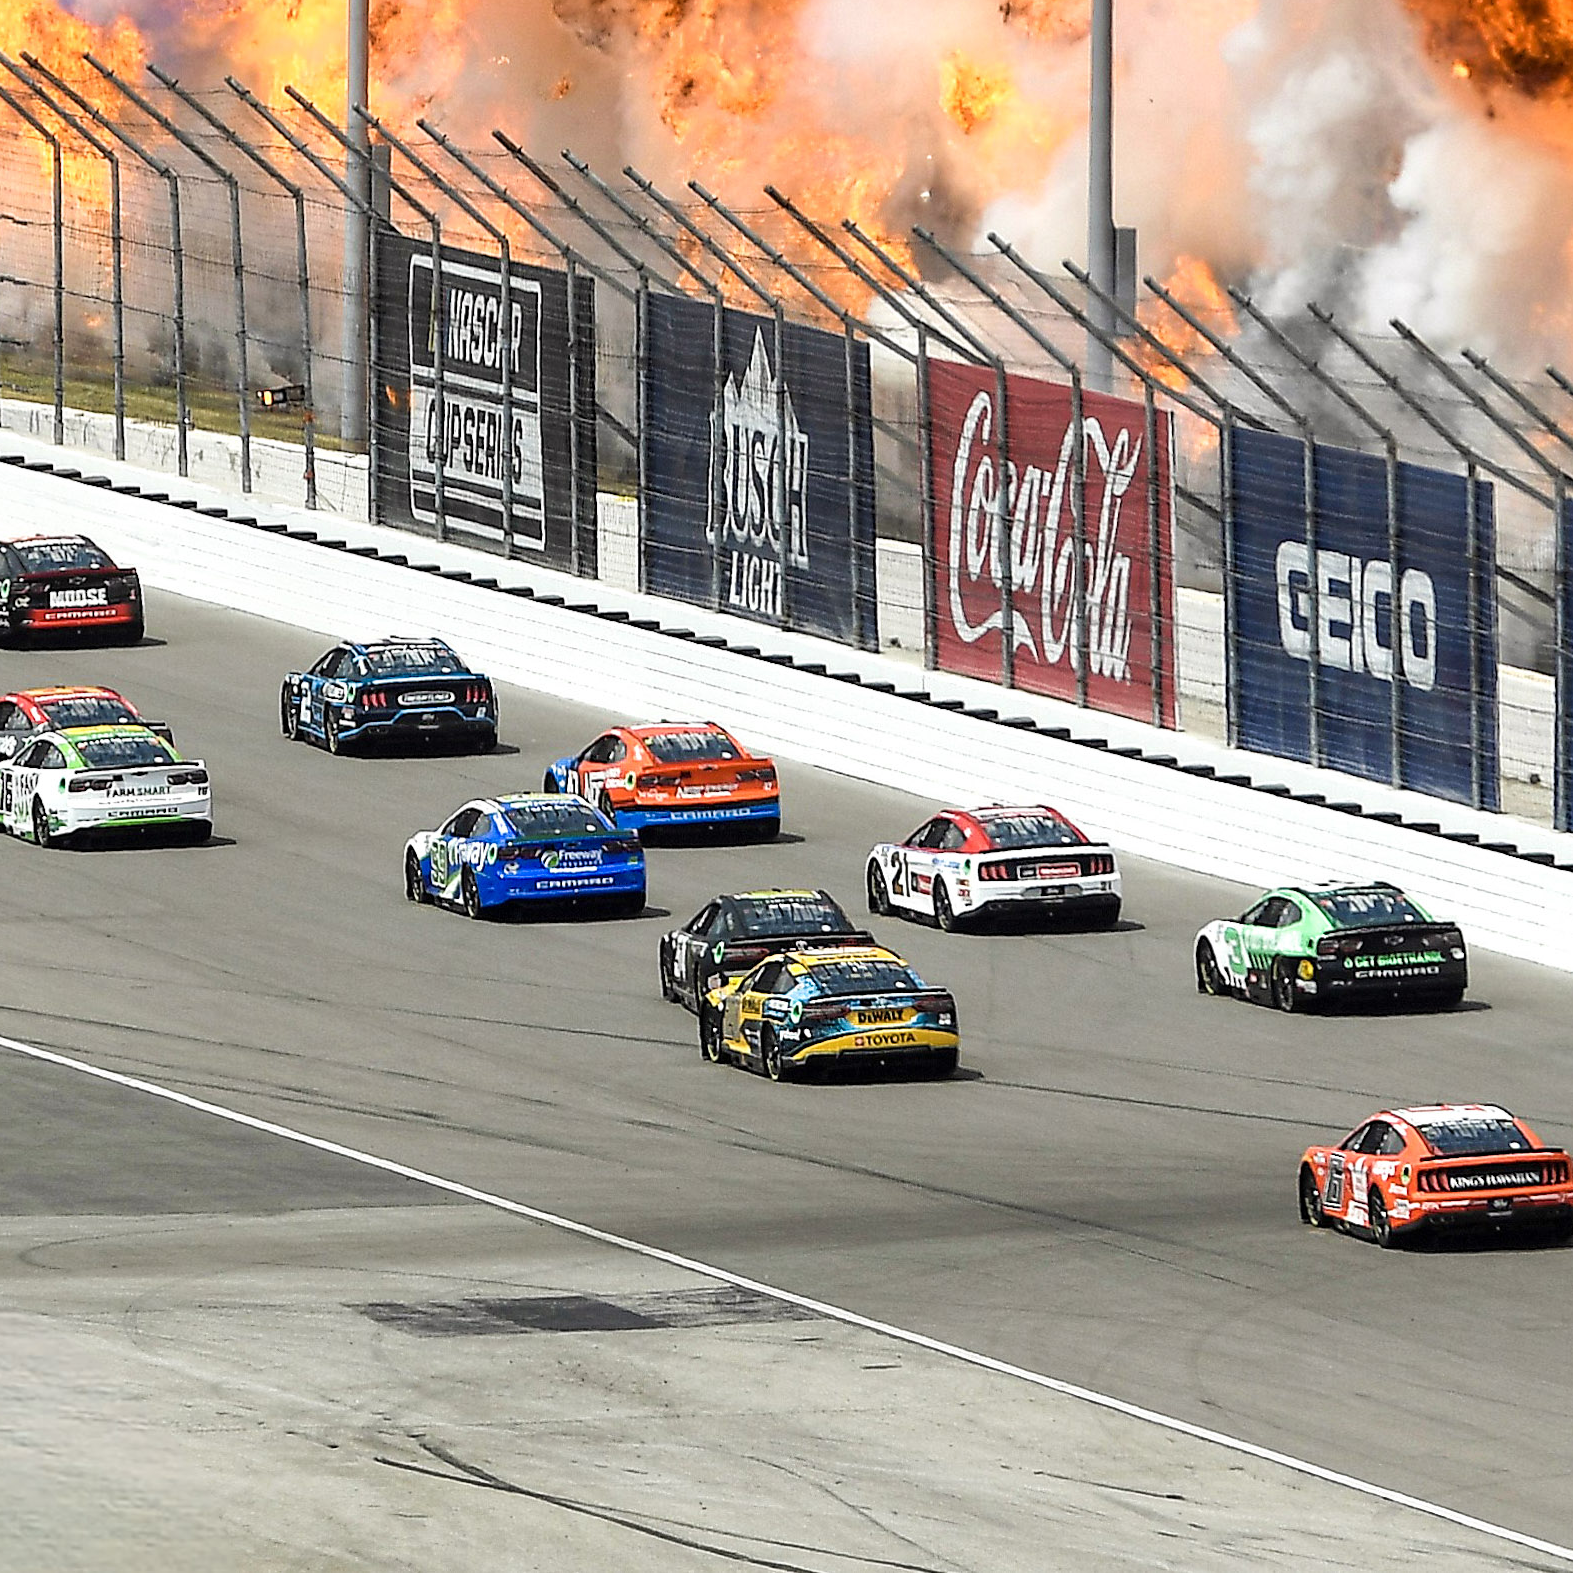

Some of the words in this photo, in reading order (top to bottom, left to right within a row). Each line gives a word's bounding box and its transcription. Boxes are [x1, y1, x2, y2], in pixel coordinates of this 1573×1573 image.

[448, 288, 522, 373] NASCAR
[463, 406, 523, 485] SERIS
[706, 411, 810, 571] USCH
[49, 587, 109, 609] MOOSE
[1277, 540, 1437, 692] GEICO
[137, 786, 172, 796] SMART
[670, 807, 752, 821] CAMARO
[559, 849, 603, 862] Freeway
[536, 876, 615, 890] CAMARO
[891, 850, 911, 898] 21
[866, 1032, 916, 1046] TOYOTA
